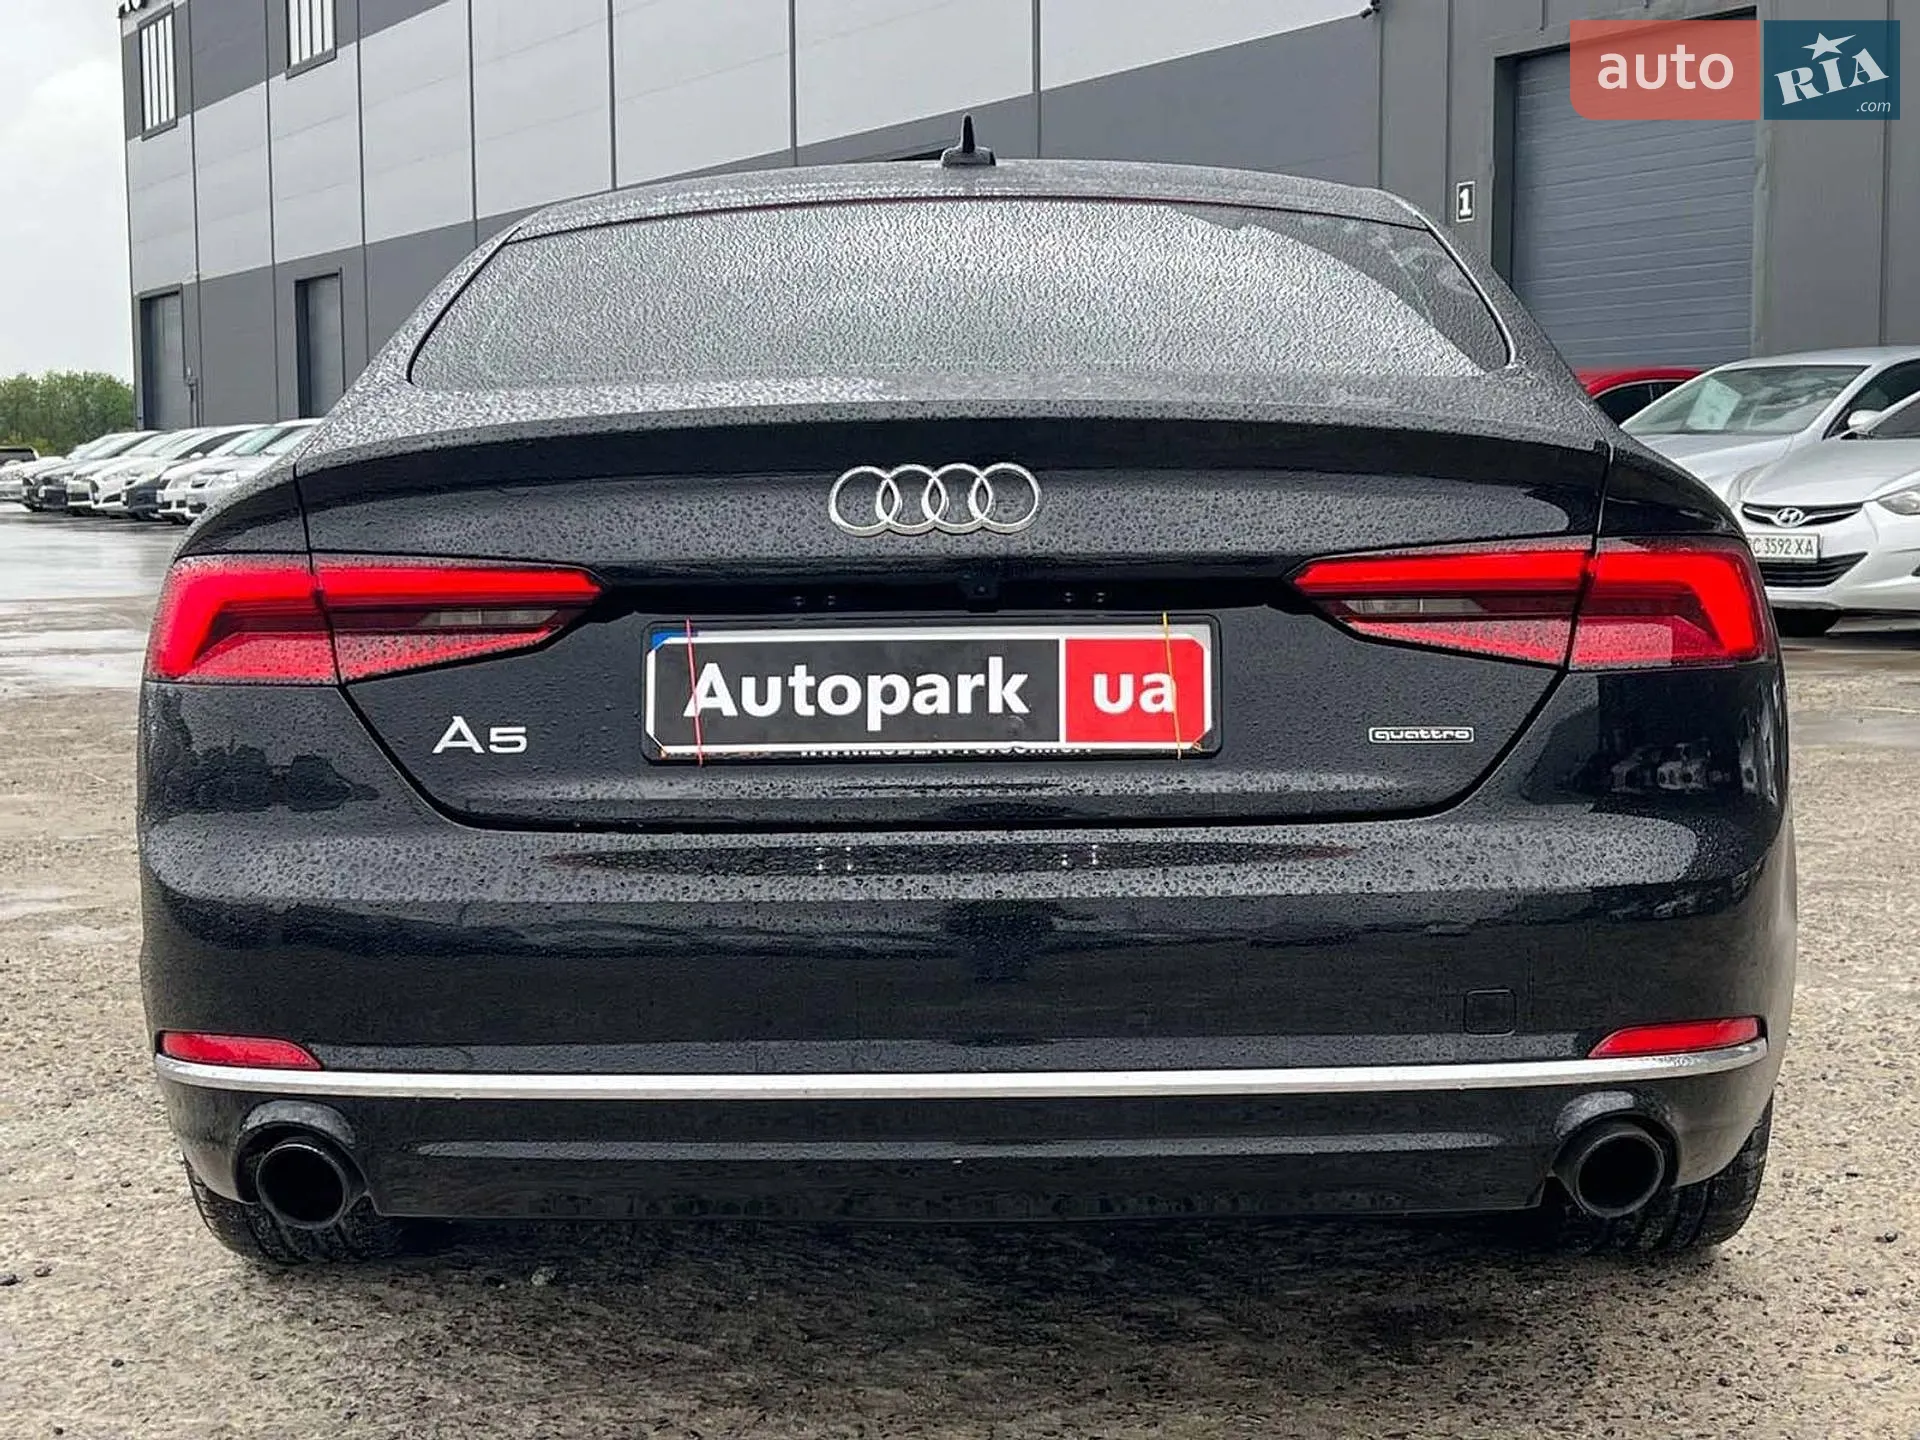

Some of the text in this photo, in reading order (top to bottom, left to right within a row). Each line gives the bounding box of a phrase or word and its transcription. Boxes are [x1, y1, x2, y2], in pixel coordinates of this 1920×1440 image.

[1459, 187, 1471, 216] 1
[1764, 537, 1792, 555] 3592
[1794, 538, 1814, 555] XA
[683, 656, 1175, 731] Autopark ua
[432, 715, 528, 754] A5
[1374, 729, 1470, 741] quattro
